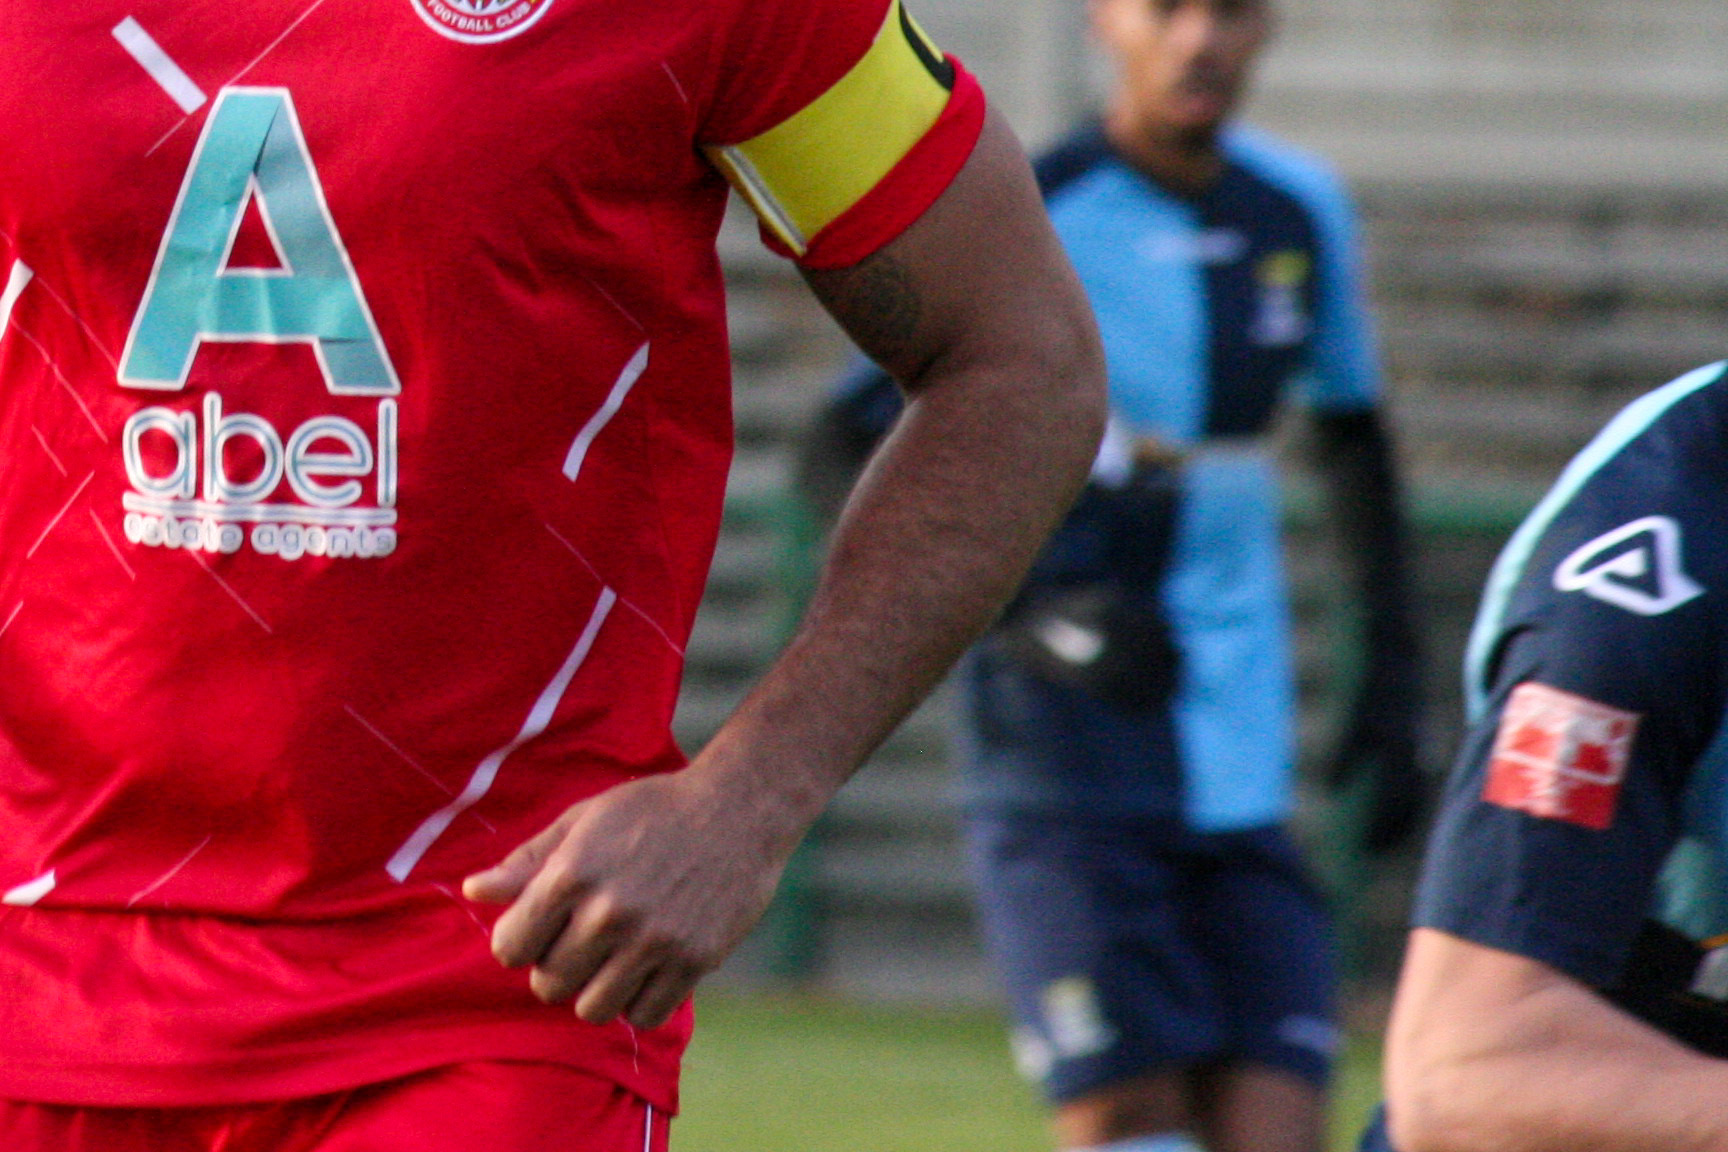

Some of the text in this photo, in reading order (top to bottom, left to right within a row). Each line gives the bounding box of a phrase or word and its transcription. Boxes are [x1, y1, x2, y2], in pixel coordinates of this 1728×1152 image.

[495, 0, 532, 29] CLUB
[122, 391, 399, 509] abel
[124, 512, 398, 562] estate agents
